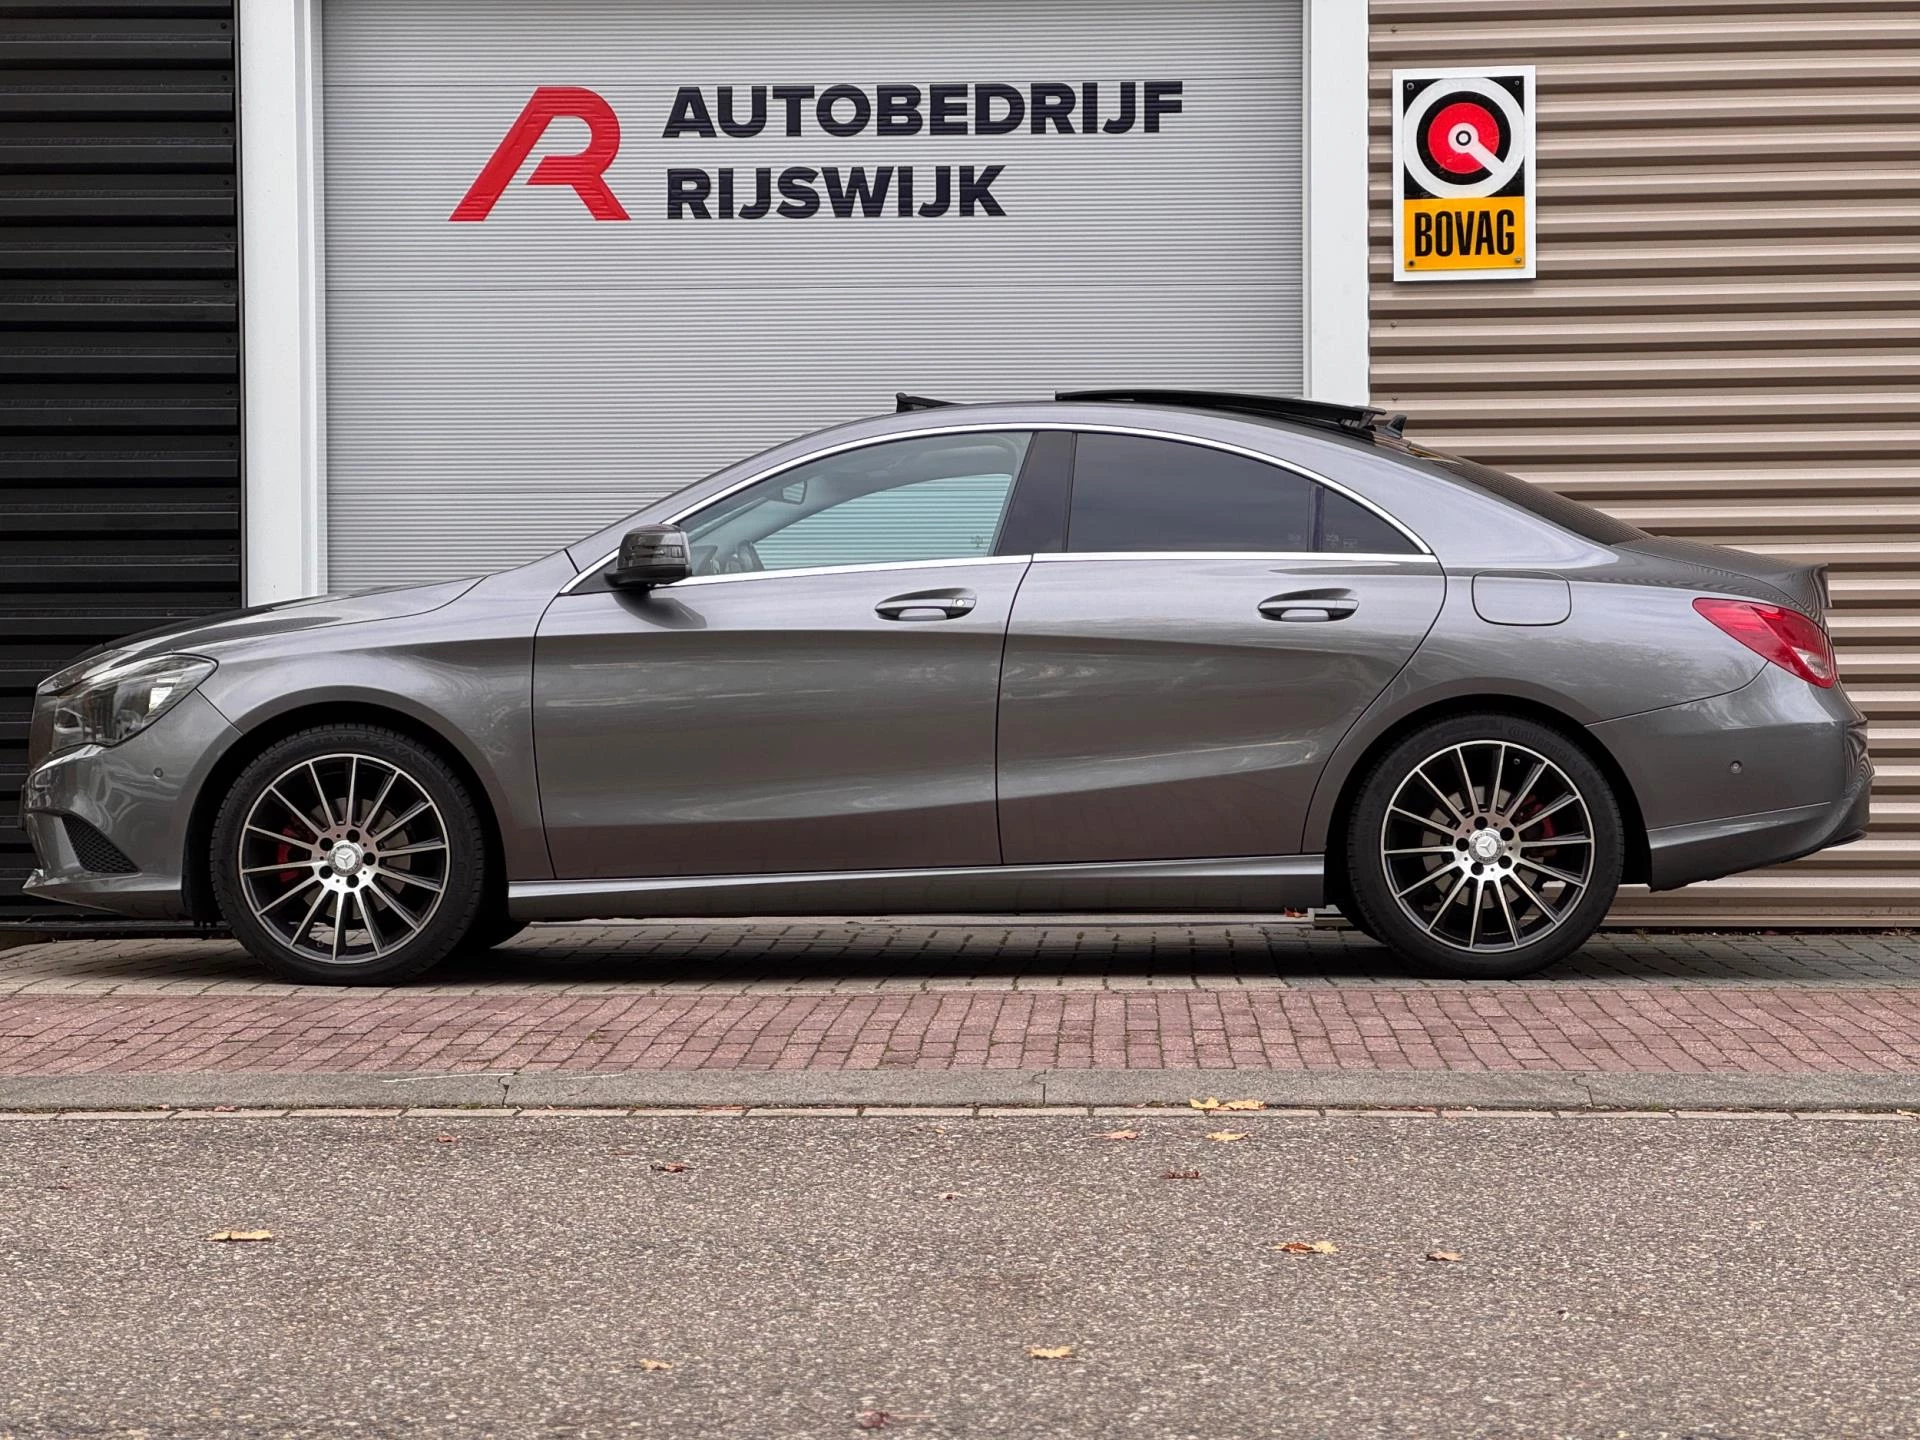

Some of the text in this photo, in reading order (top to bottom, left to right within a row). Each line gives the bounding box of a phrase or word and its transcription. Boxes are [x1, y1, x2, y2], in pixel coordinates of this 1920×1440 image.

[662, 81, 1183, 138] AUTOBEDRIJF
[667, 165, 1008, 220] RIJSWIJK
[1414, 209, 1515, 257] BOVAG
